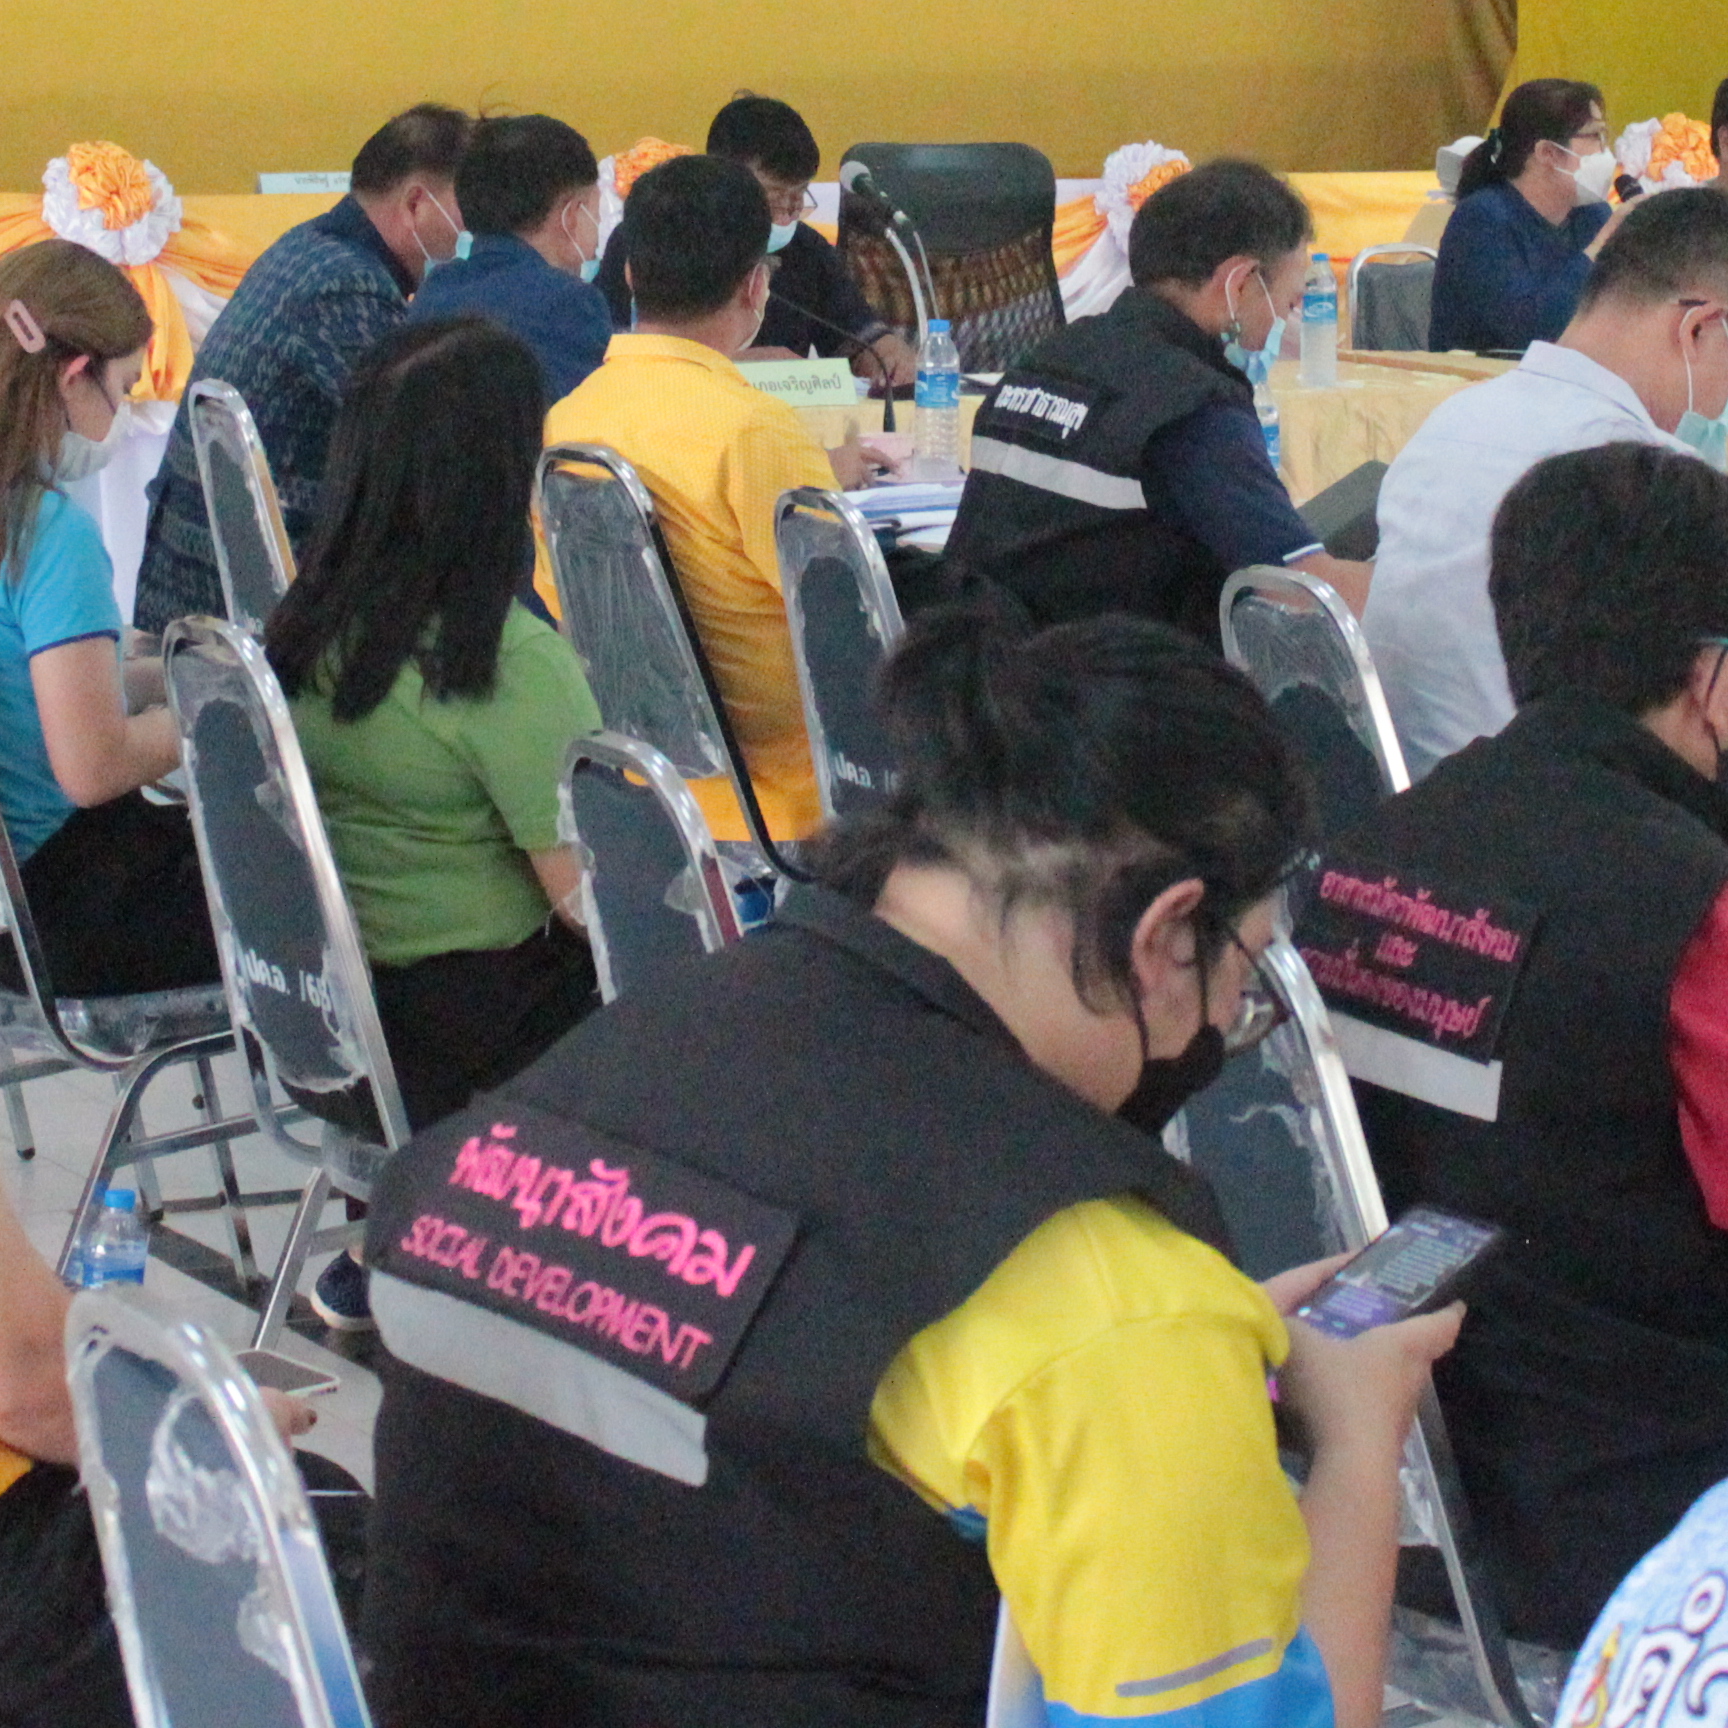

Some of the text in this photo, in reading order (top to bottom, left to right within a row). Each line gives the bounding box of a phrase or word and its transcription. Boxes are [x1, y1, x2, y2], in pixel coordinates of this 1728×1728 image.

[752, 373, 842, 395] เภอเจริญศิลป์
[401, 1214, 713, 1370] SOCIAL DEVELOPMENT
